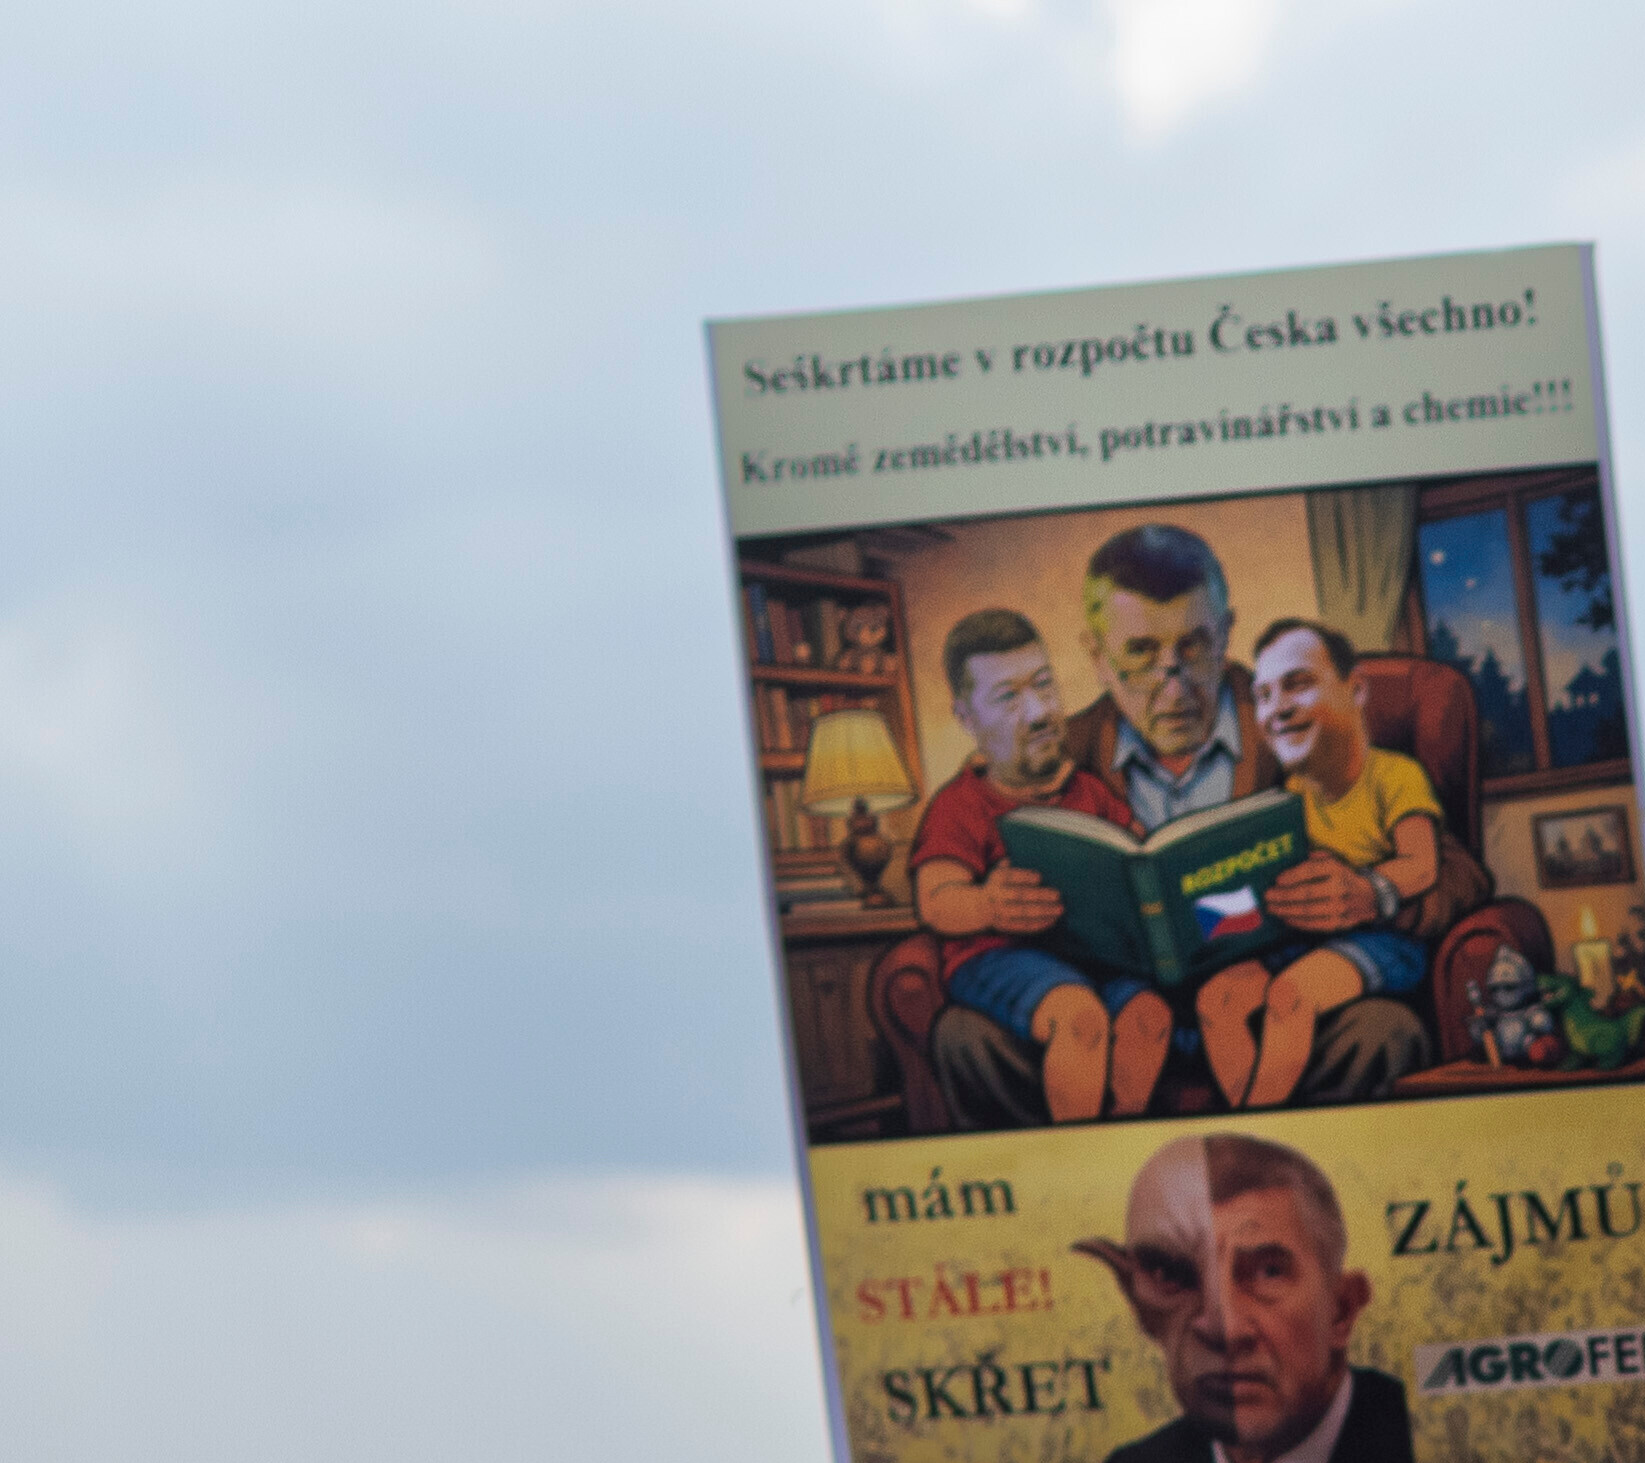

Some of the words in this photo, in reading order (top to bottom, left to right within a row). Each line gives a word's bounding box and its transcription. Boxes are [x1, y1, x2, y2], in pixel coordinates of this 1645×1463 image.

[743, 345, 961, 397] Seškrtáme
[974, 347, 994, 374] v
[1012, 322, 1197, 378] rozpočtu
[1208, 303, 1339, 355] Česka
[1352, 286, 1538, 338] všechno!
[1098, 395, 1361, 463] potravinářství
[1370, 402, 1392, 429] a
[1401, 376, 1574, 427] chemie!!!
[860, 1166, 1019, 1224] mám
[855, 1262, 1056, 1327] STÁLE!
[880, 1350, 1115, 1424] SKŘET
